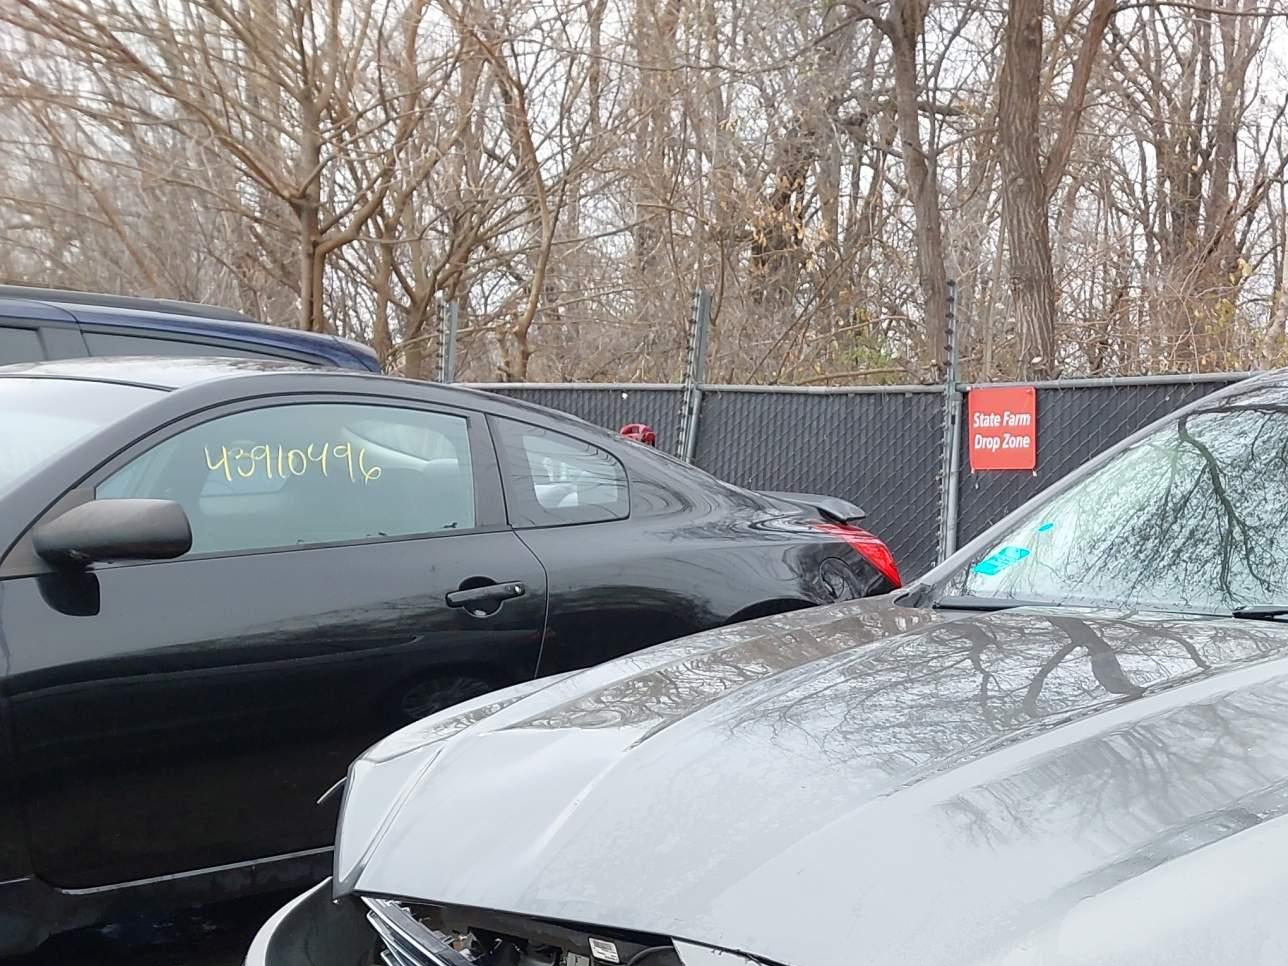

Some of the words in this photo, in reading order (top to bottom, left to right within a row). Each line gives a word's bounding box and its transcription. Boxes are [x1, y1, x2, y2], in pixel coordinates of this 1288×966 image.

[973, 412, 1001, 428] State
[1003, 411, 1031, 426] Farm
[974, 434, 1000, 453] Drop
[1002, 433, 1030, 449] Zone
[204, 442, 382, 486] 43910496
